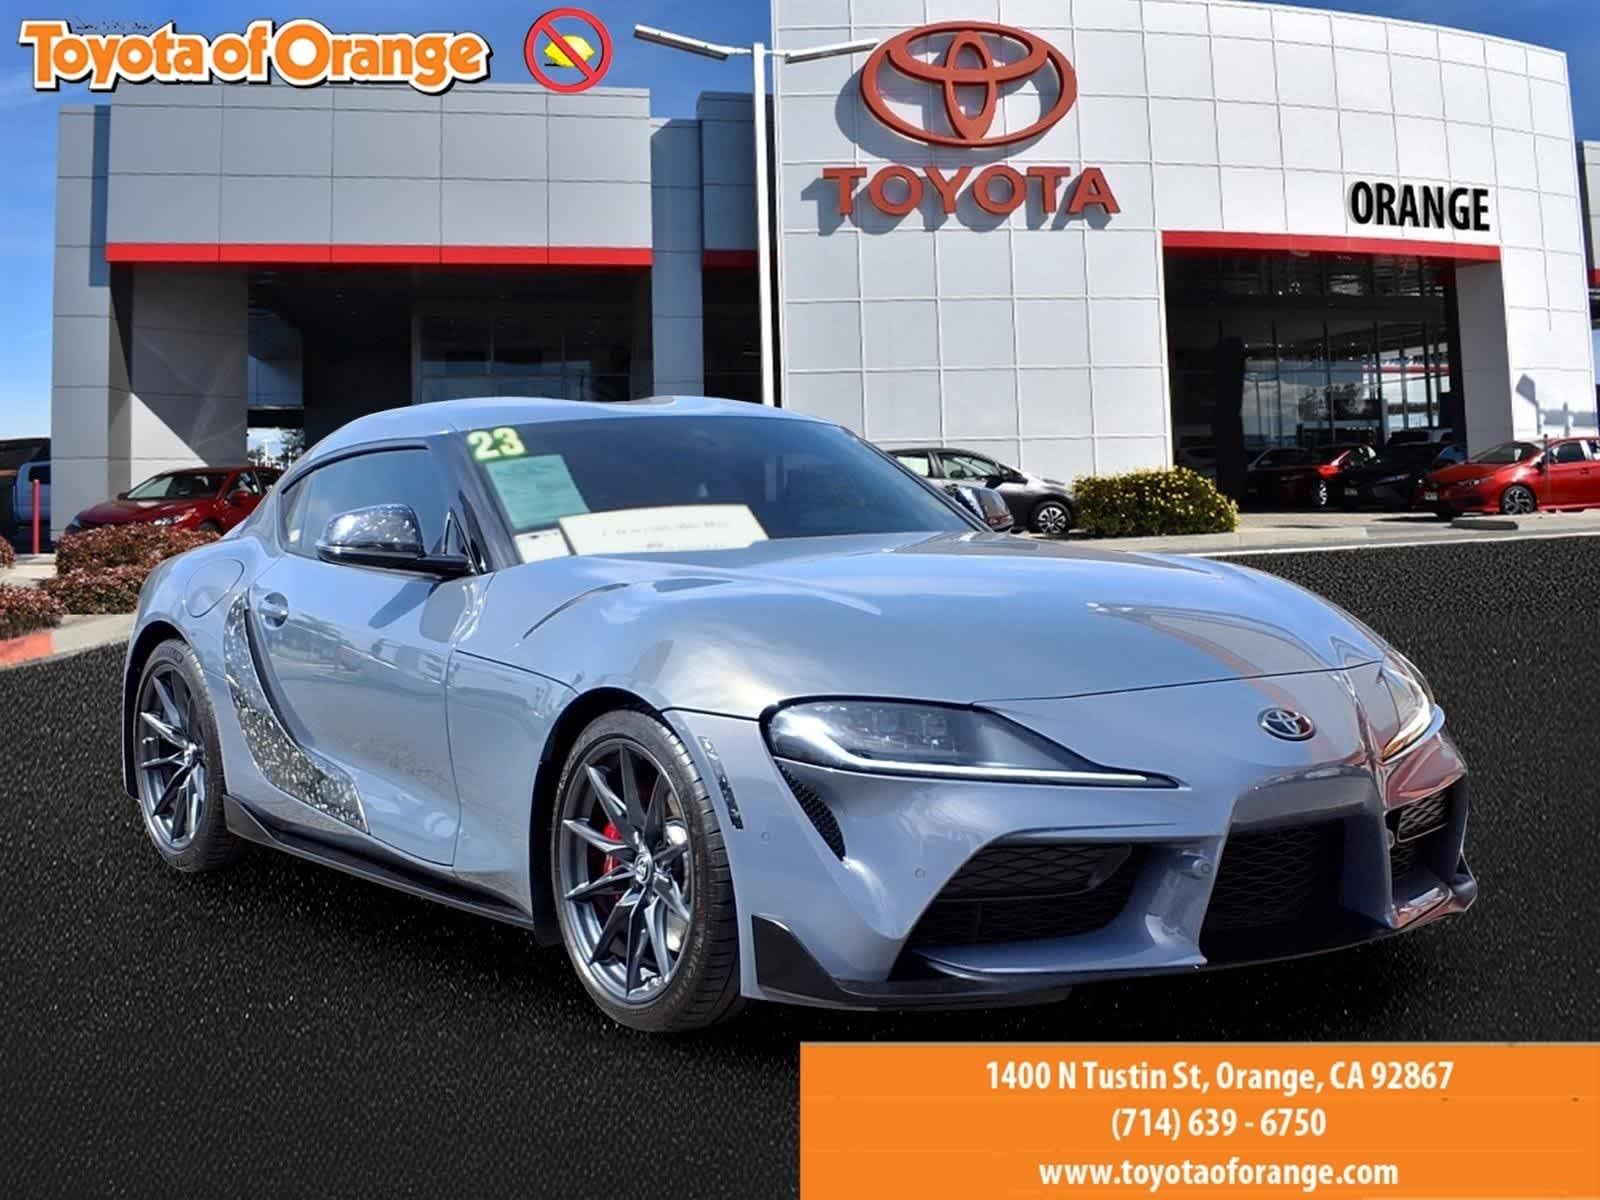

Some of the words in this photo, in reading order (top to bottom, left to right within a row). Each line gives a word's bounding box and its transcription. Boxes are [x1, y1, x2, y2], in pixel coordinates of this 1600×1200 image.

[822, 164, 1121, 216] TOYOTA
[1350, 180, 1491, 232] ORANGE
[465, 427, 526, 462] 23
